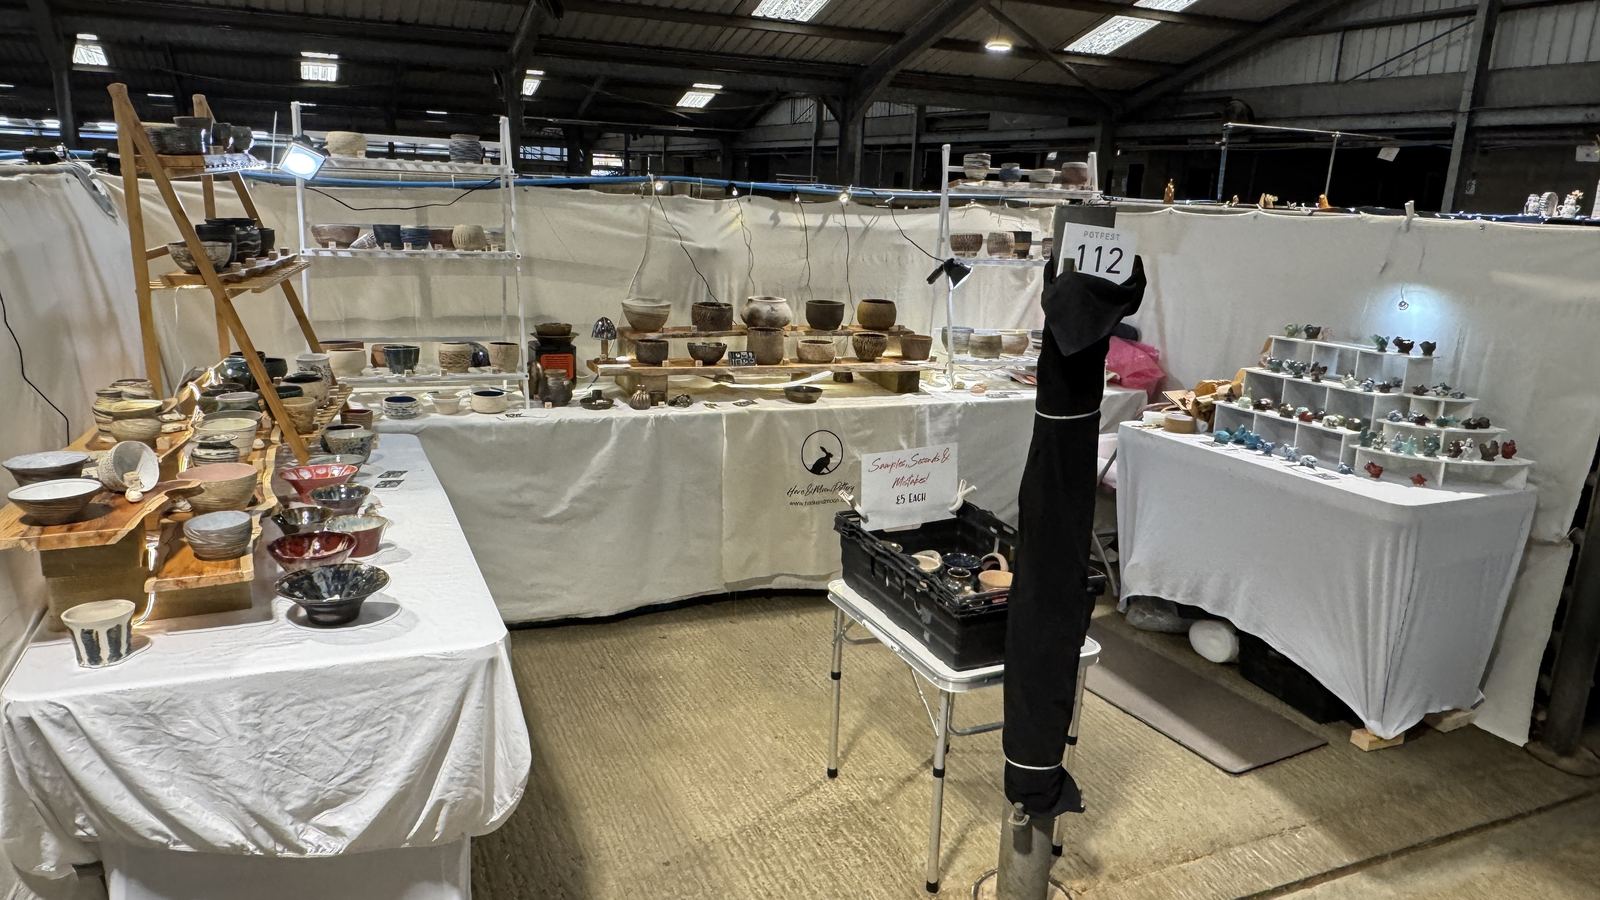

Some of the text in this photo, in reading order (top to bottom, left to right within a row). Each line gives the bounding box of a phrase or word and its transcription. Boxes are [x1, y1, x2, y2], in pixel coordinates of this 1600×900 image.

[1083, 230, 1120, 241] POTFEST
[1077, 244, 1124, 275] 112
[895, 492, 927, 505] £5 EACH
